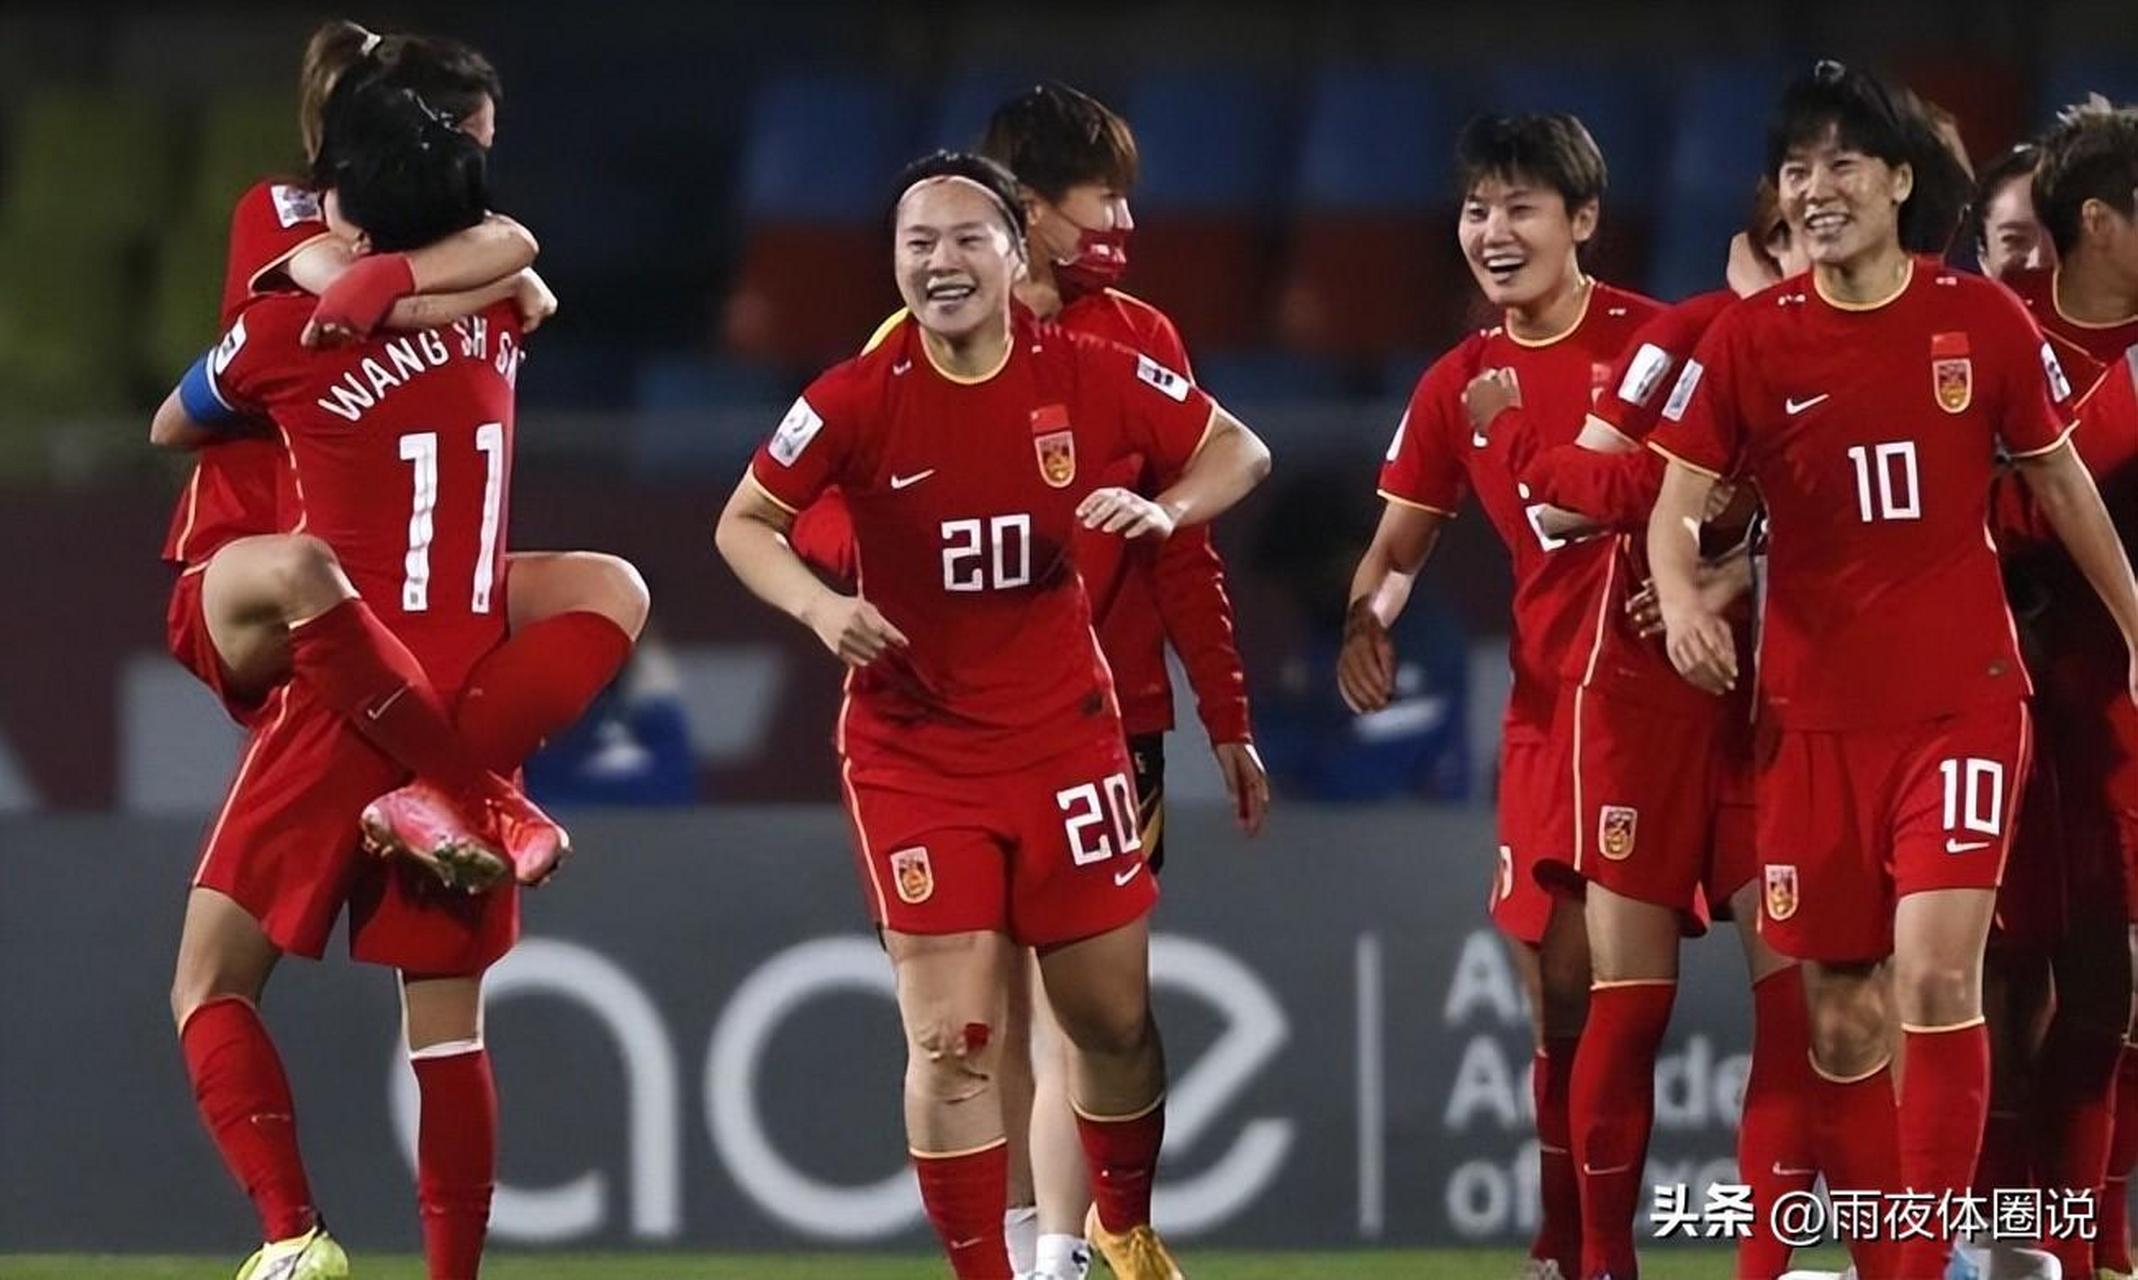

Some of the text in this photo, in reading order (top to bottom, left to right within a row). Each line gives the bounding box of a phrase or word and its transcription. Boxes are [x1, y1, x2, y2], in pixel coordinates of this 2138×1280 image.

[318, 329, 449, 421] WANG
[400, 422, 504, 613] 11
[1848, 441, 1921, 522] 10
[941, 513, 1031, 591] 20
[1056, 772, 1143, 866] 20
[1939, 758, 2003, 836] 10
